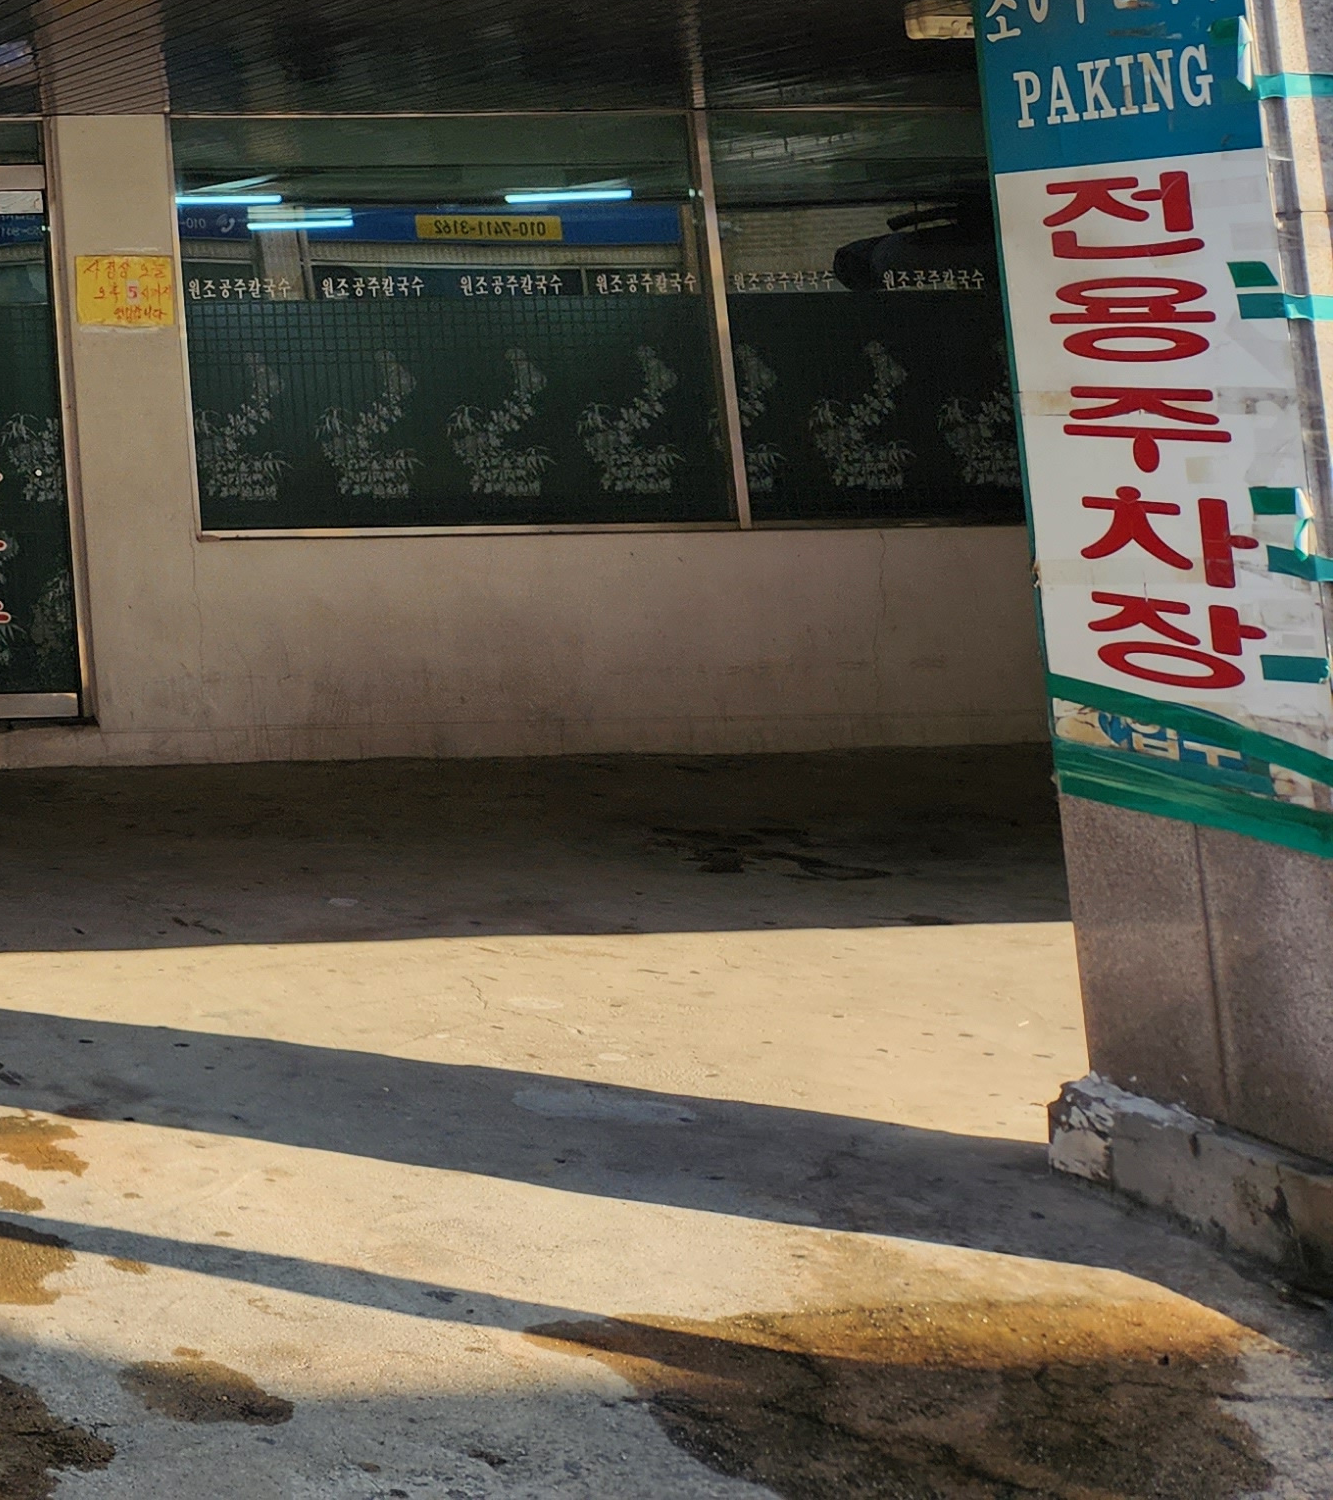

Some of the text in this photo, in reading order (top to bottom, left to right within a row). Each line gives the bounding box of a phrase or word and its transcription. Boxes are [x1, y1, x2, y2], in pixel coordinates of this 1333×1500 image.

[1012, 43, 1215, 130] PAKING
[139, 262, 166, 279] 오늘
[1042, 170, 1267, 690] 전용주차장
